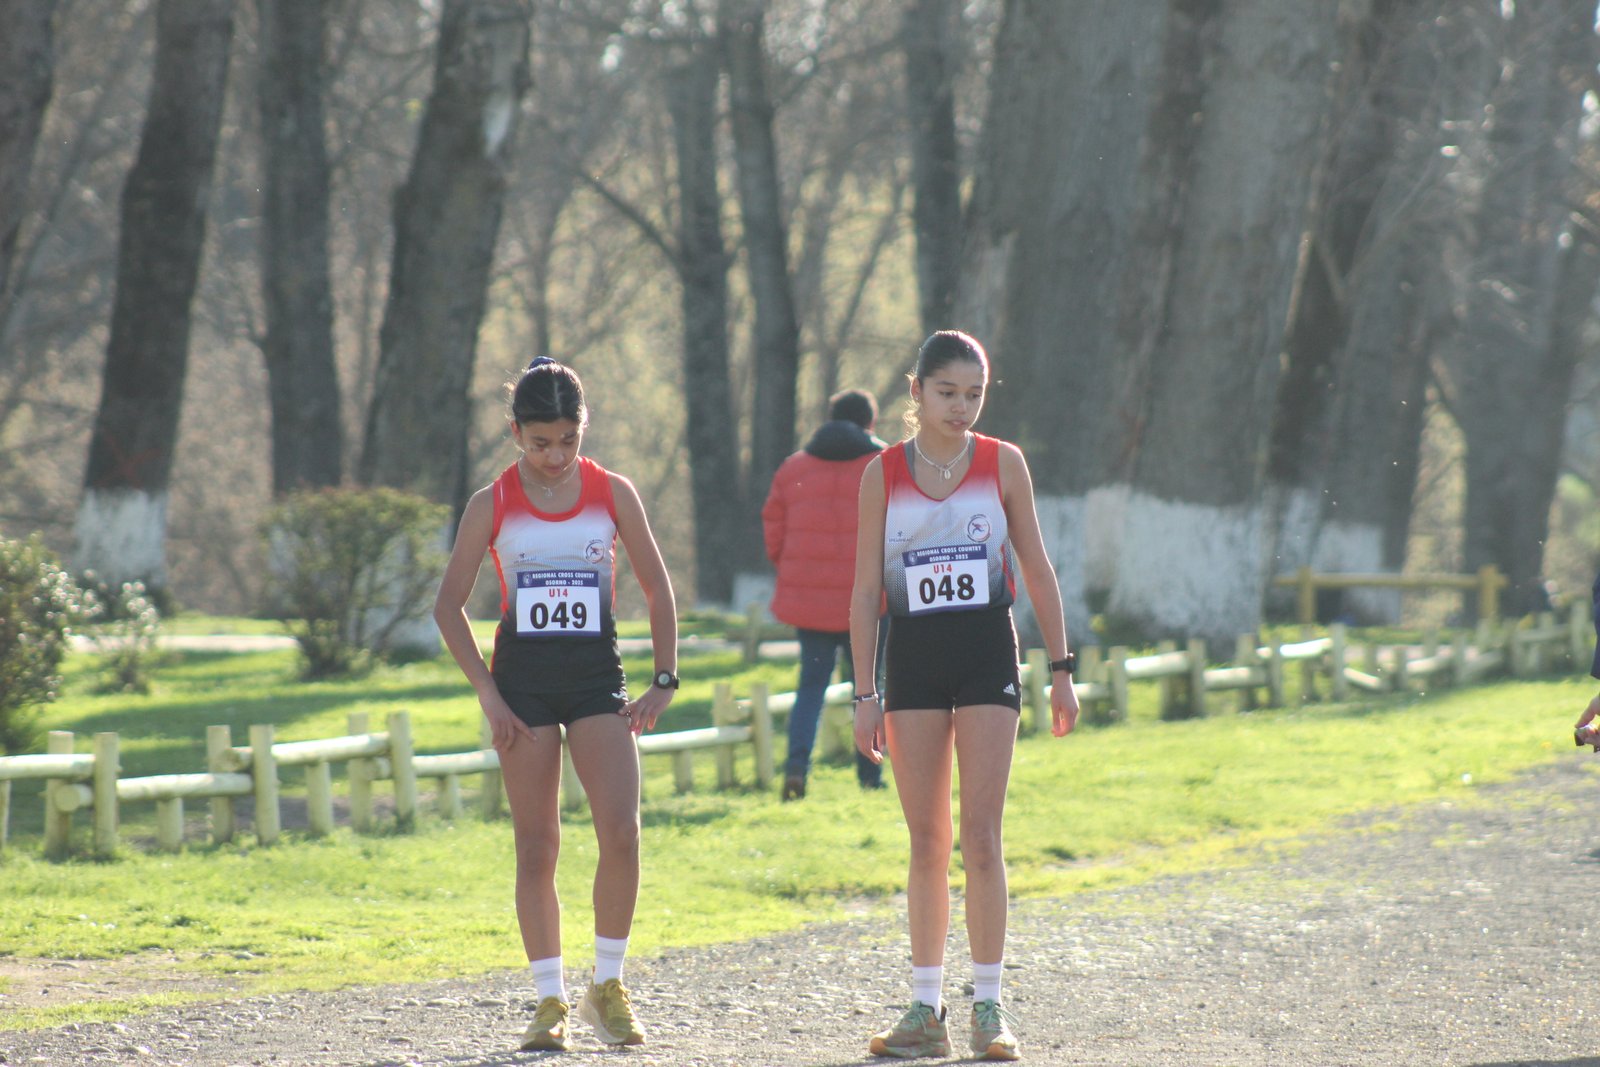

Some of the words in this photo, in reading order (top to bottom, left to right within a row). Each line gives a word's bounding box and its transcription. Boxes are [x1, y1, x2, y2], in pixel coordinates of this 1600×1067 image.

[916, 548, 940, 556] REGIONAL
[933, 564, 952, 574] U14
[549, 588, 568, 597] U14
[919, 574, 975, 604] 048
[530, 601, 587, 630] 049
